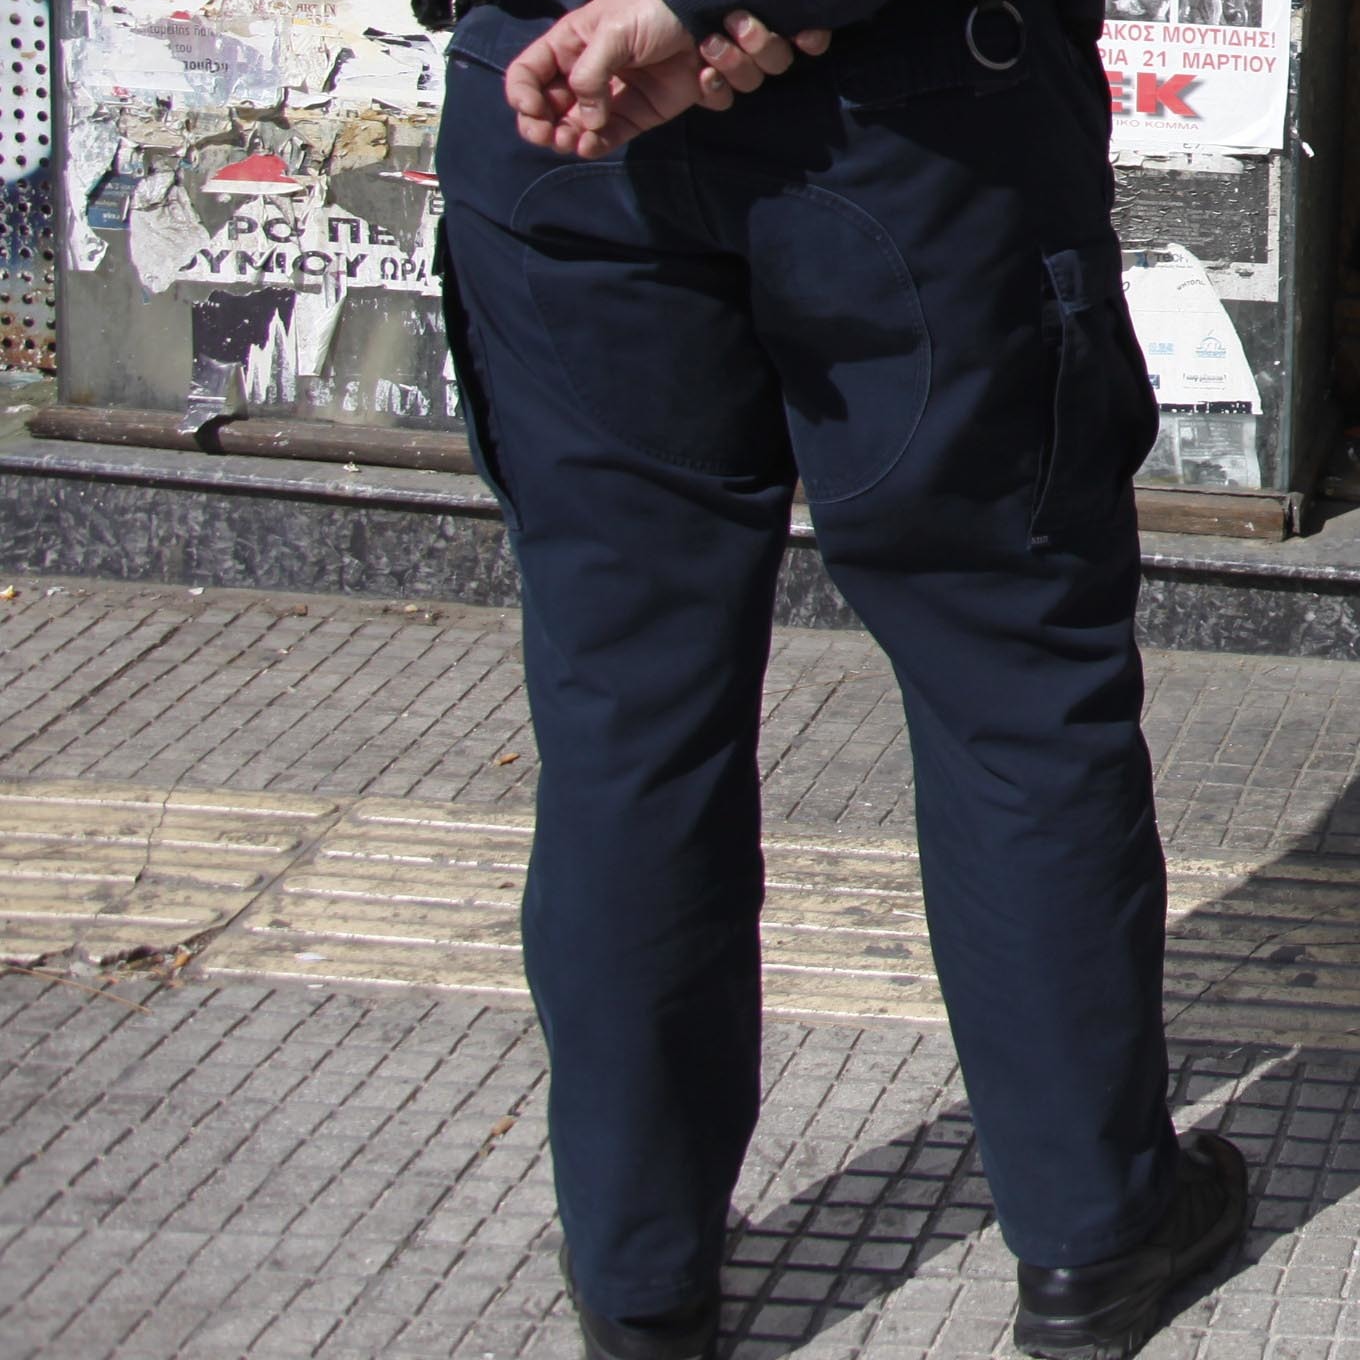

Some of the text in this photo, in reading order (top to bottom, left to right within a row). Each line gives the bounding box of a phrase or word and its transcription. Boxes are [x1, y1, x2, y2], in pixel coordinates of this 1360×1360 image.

[1162, 25, 1277, 49] ΜΟΥΤΙΔΗΣ!
[1142, 50, 1277, 73] 21 ΜΑΡΤΙΟΥ
